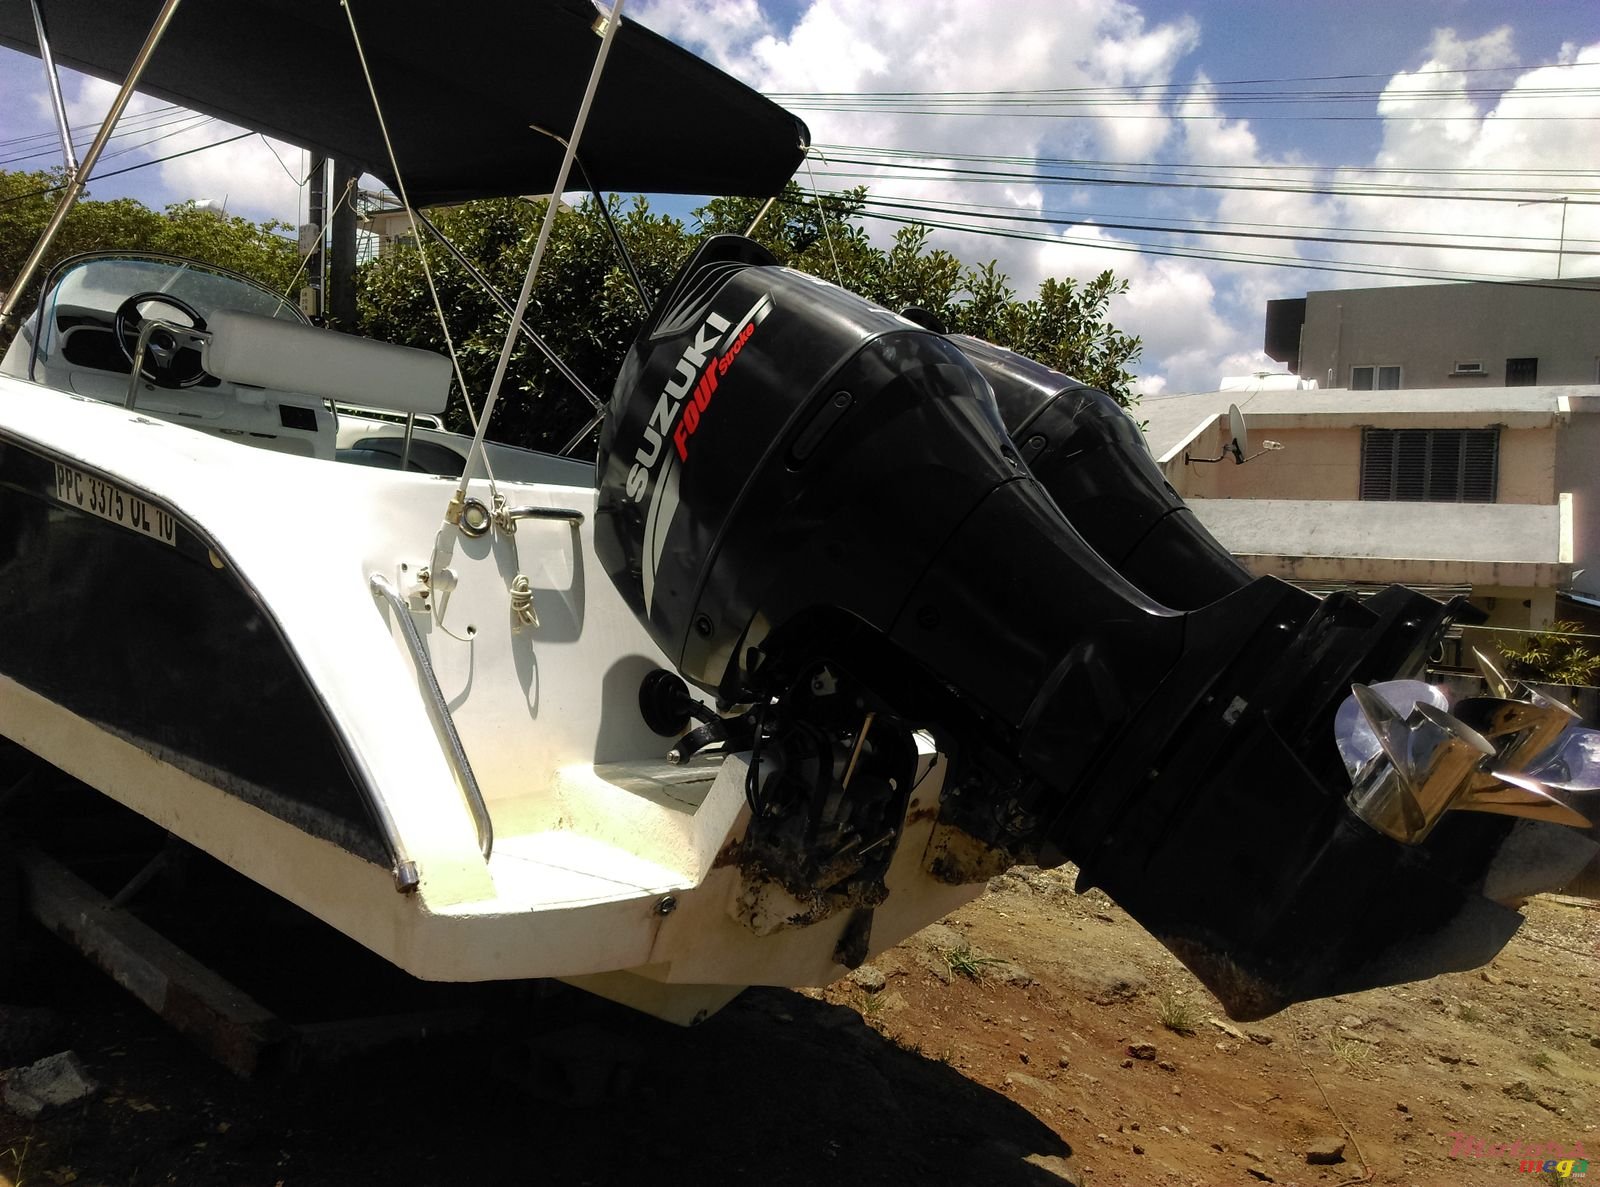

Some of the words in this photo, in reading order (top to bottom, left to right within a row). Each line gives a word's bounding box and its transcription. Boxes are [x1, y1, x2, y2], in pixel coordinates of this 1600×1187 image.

[718, 322, 755, 376] Stroke
[625, 311, 731, 503] SUZUKI
[56, 463, 83, 506] PPC
[88, 477, 124, 522] 3375
[156, 509, 173, 541] 10
